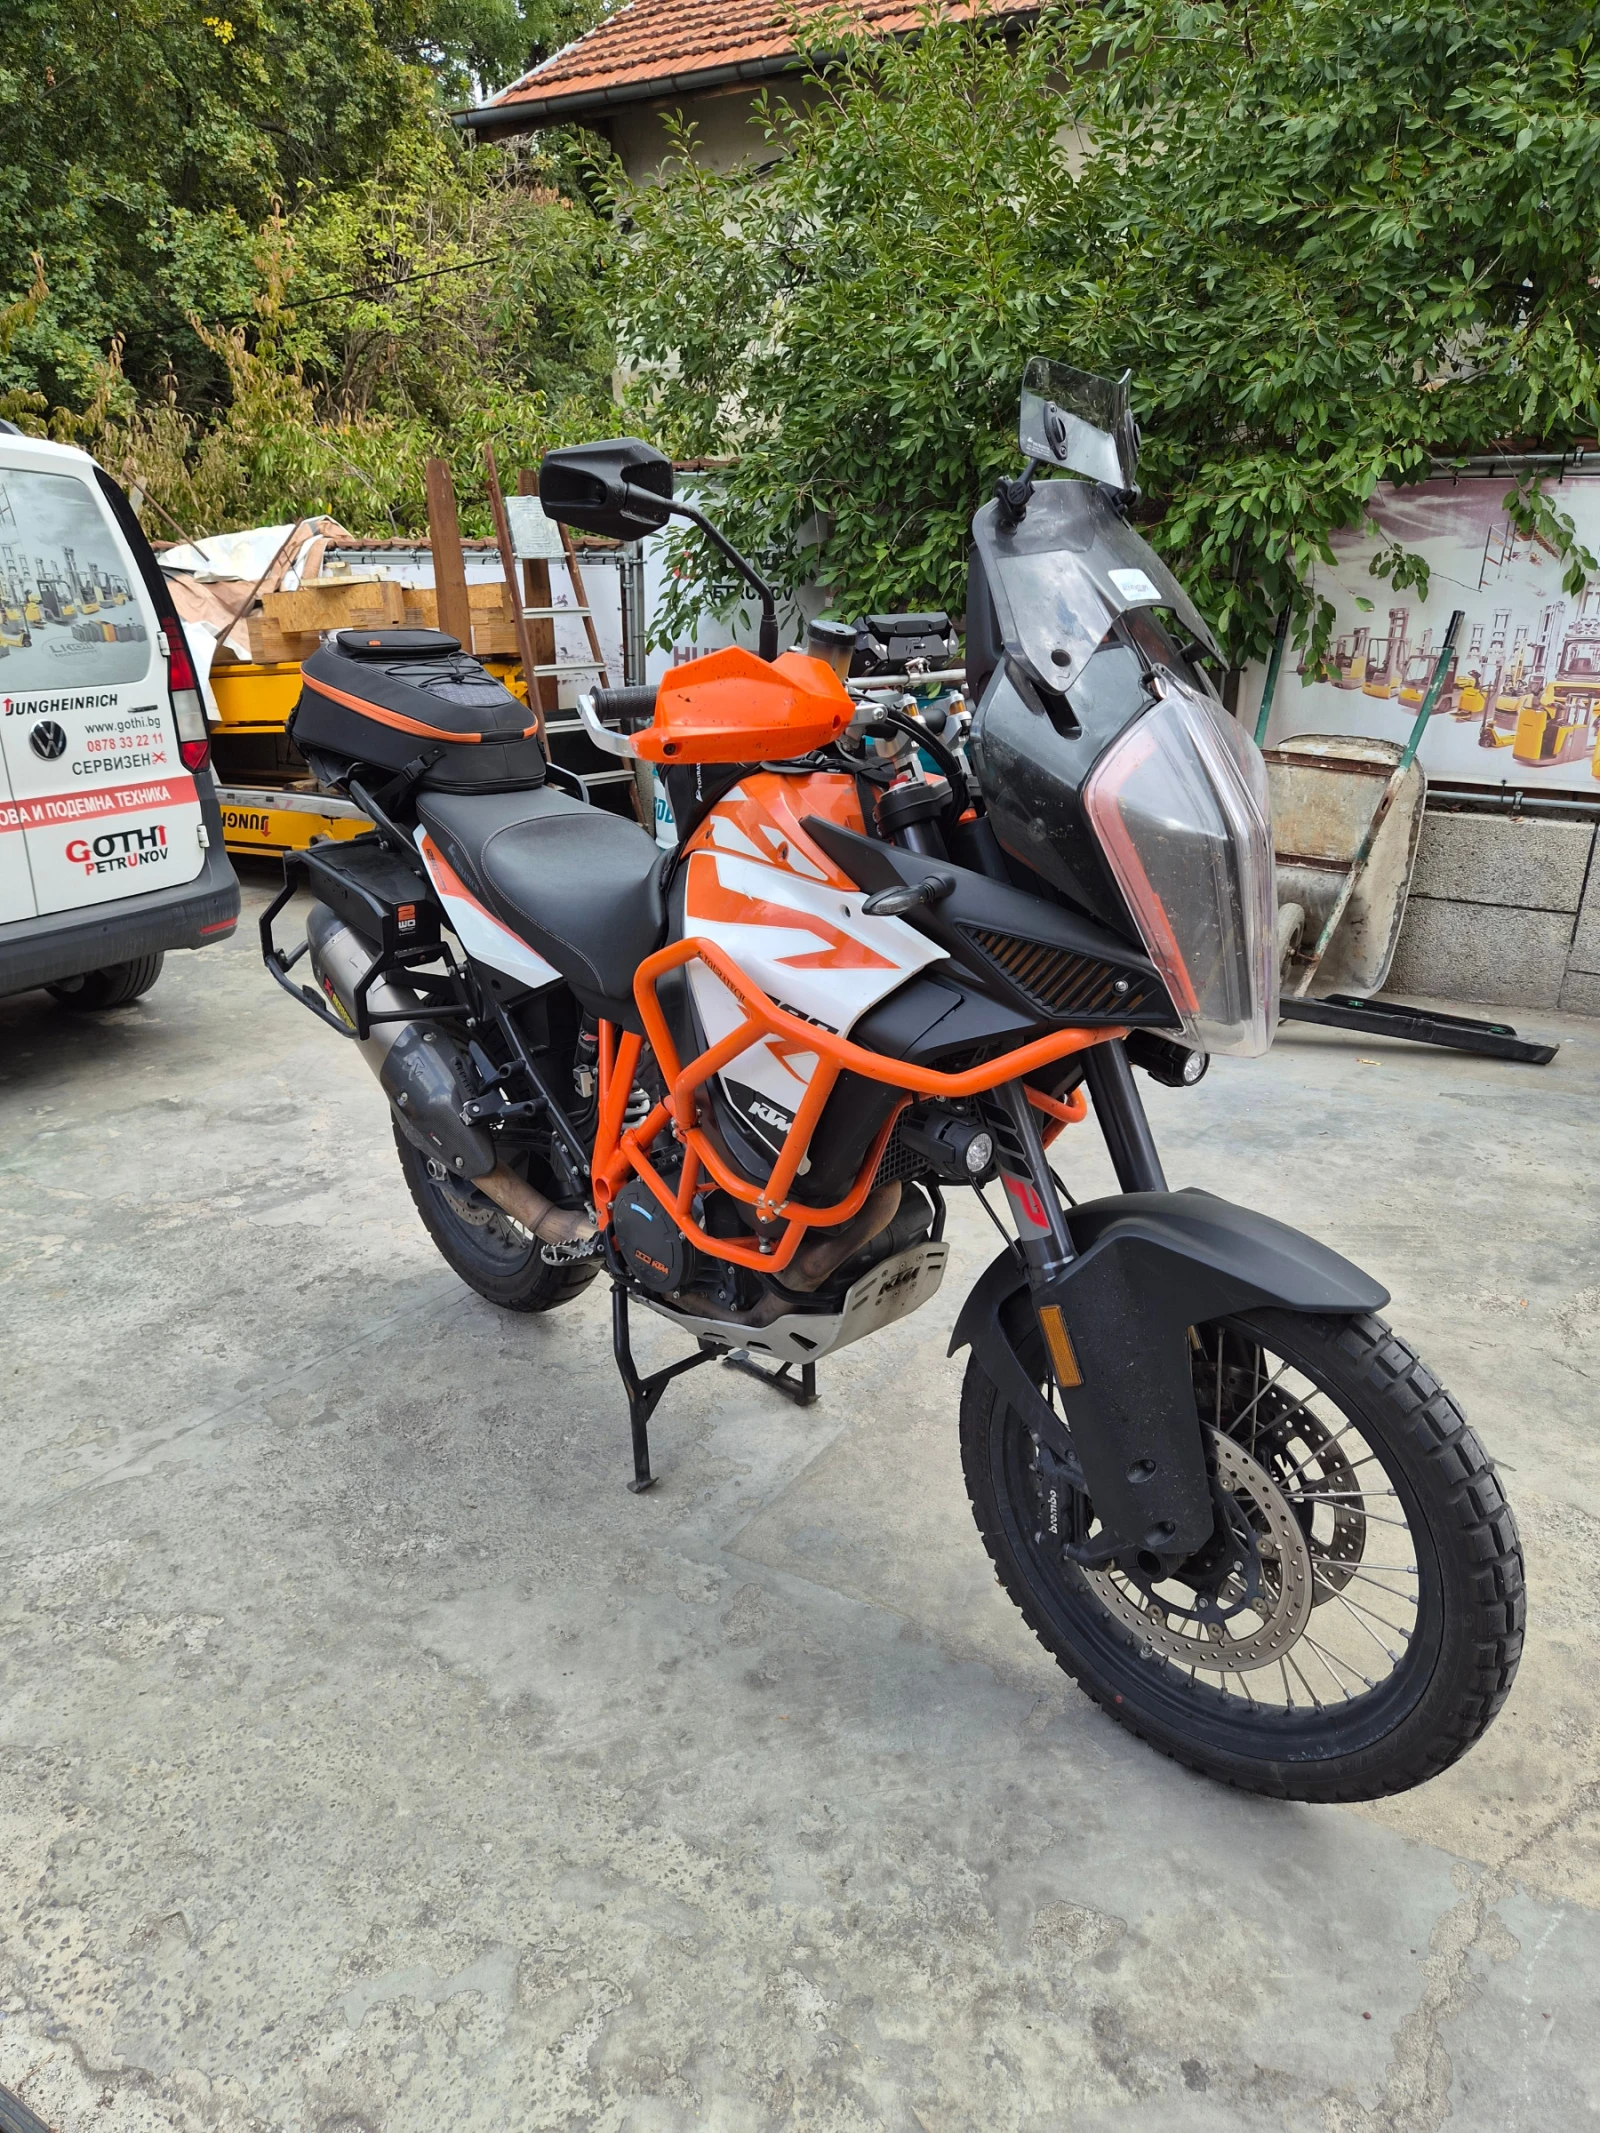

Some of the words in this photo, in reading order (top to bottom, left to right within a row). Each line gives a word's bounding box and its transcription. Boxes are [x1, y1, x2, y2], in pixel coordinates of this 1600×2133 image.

[4, 694, 118, 716] JUNGHEINRICH
[85, 717, 161, 734] www.gothi.bg
[87, 738, 117, 753] 0878
[119, 736, 134, 749] 33
[136, 734, 150, 748] 22
[152, 732, 164, 745] 11
[72, 753, 151, 775] СЕРВИЗЕН
[31, 804, 45, 821] И
[46, 794, 117, 818] ПОДЕМНА
[115, 785, 172, 807] ТЕХНИКА
[66, 824, 167, 863] GOTHI
[85, 847, 169, 876] PETRUNOV
[748, 1101, 793, 1134] KTM
[877, 1266, 921, 1297] KTM
[1047, 1489, 1058, 1535] brembo
